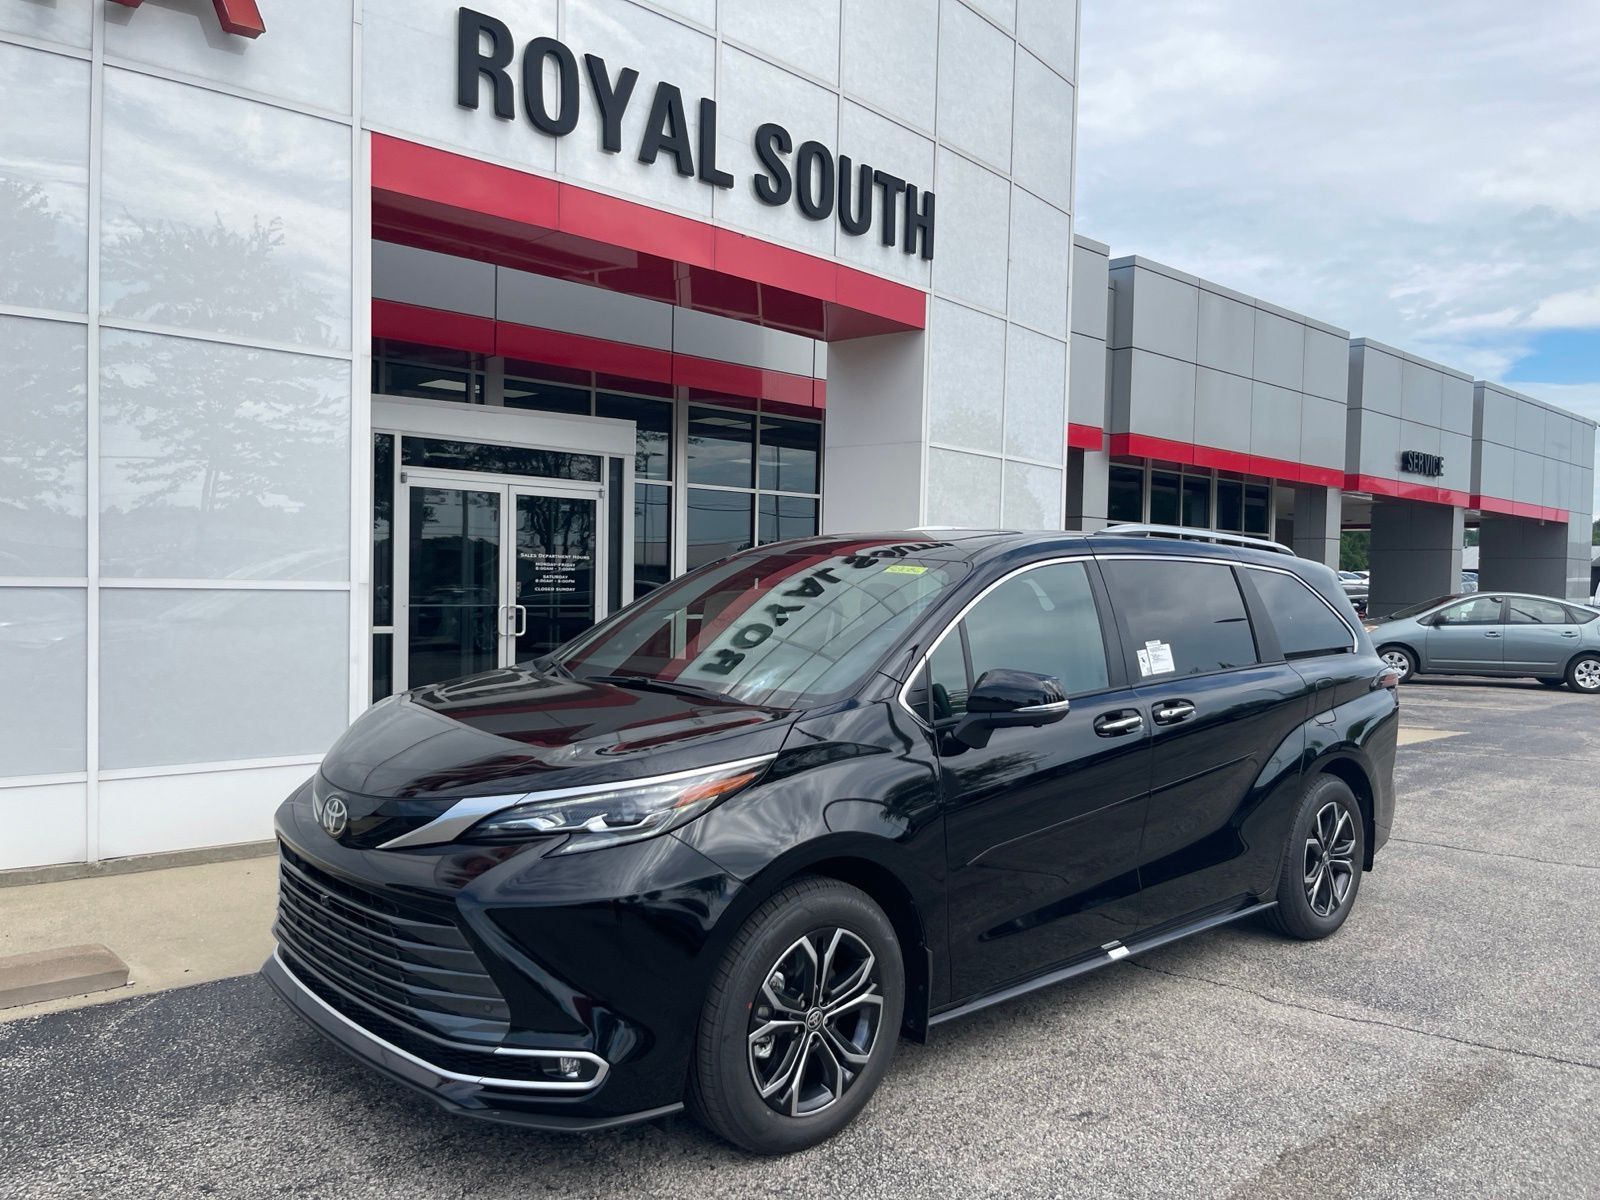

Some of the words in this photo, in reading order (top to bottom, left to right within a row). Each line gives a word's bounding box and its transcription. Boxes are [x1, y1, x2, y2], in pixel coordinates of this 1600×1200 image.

[458, 6, 734, 189] ROYAL
[754, 122, 936, 261] SOUTH
[1402, 450, 1445, 477] SERVICE
